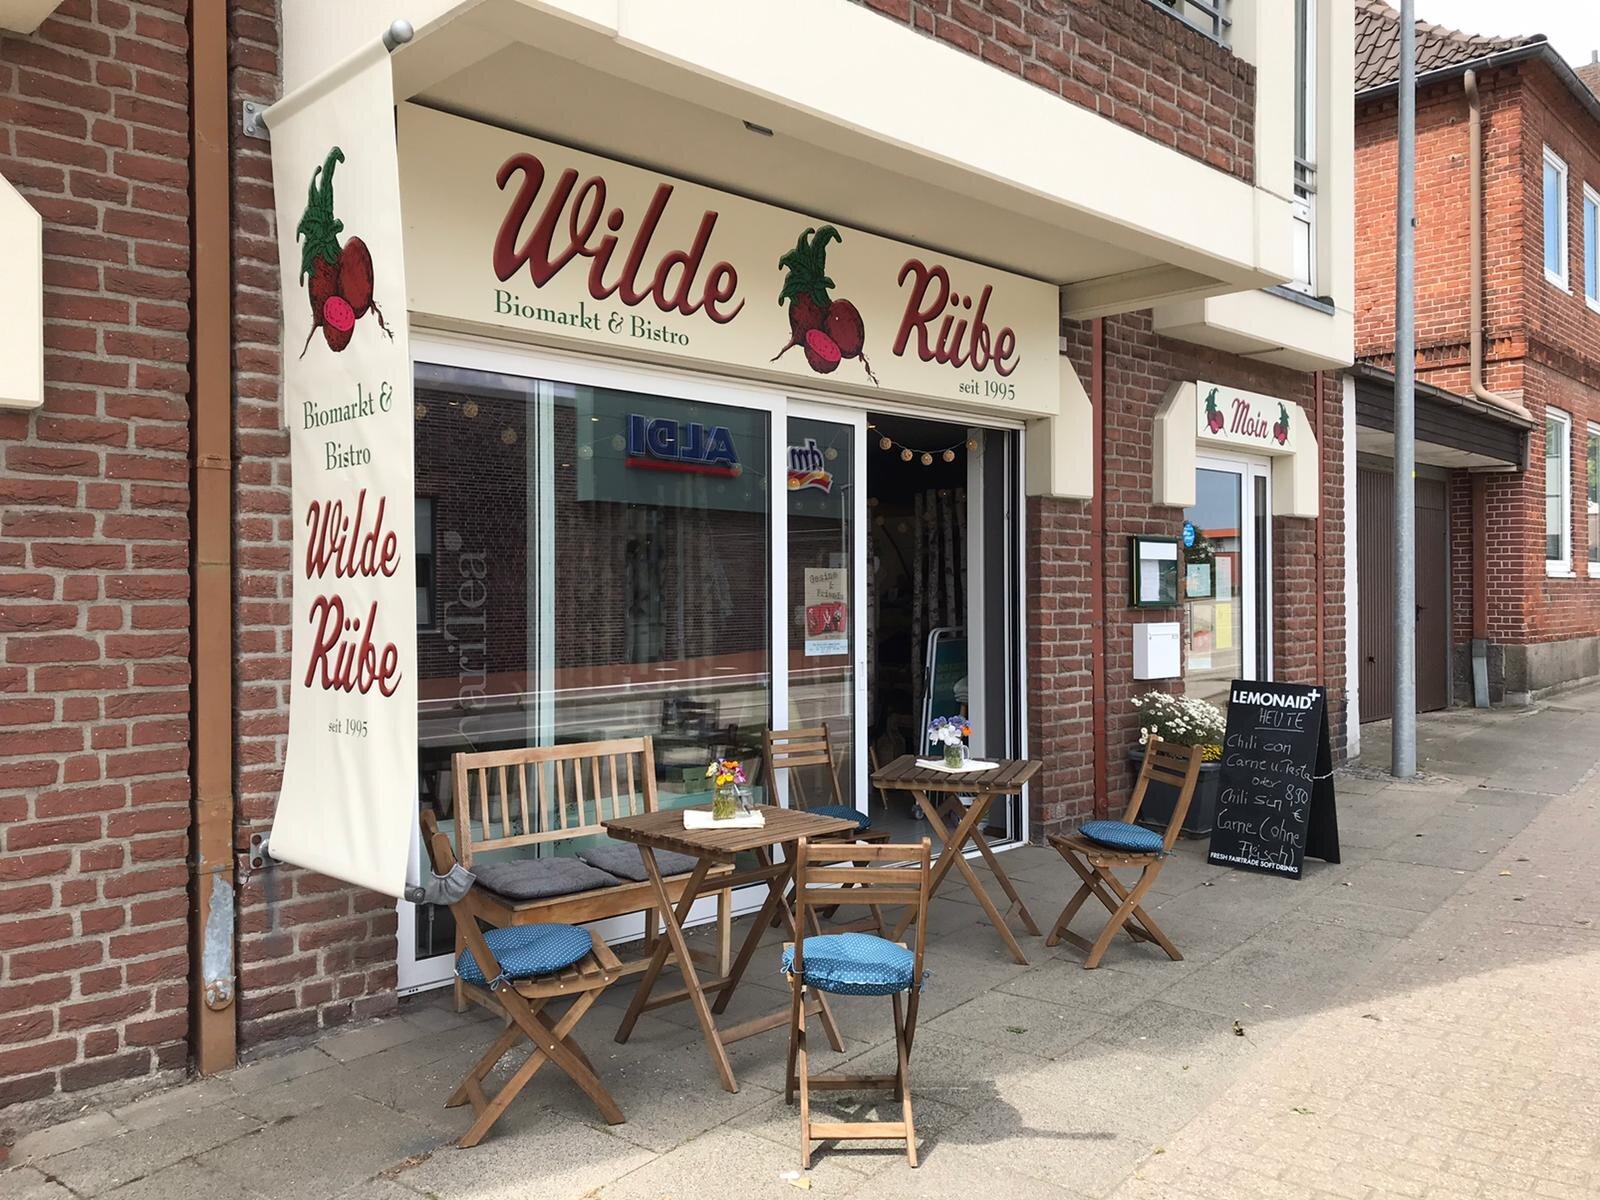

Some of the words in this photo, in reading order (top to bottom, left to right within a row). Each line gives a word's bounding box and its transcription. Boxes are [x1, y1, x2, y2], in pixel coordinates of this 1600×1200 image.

[493, 152, 745, 324] Wilde
[893, 258, 1020, 377] Rübe
[494, 289, 601, 331] Biomarkt
[608, 311, 624, 334] &
[630, 315, 689, 346] Bistro
[959, 379, 979, 395] seit
[984, 380, 1015, 400] 1995
[303, 382, 375, 430] Biomarkt
[379, 381, 393, 412] &
[1230, 398, 1269, 439] Moin
[325, 441, 371, 470] Bistro
[306, 488, 401, 580] Wilde
[304, 594, 402, 698] Rübe
[328, 720, 342, 734] seit
[345, 718, 368, 737] 1995
[1259, 708, 1306, 729] HEUTE
[1227, 734, 1257, 749] Chili
[1263, 743, 1291, 755] con
[1226, 753, 1266, 770] Carne
[1252, 777, 1281, 788] oder
[1221, 788, 1248, 804] Chili
[1217, 808, 1257, 834] Carne
[1292, 809, 1304, 823] €
[1210, 851, 1228, 860] FRESH
[1228, 854, 1259, 866] FAIRTRADE
[1260, 861, 1276, 869] SOFT
[1275, 863, 1299, 873] DRINKS
